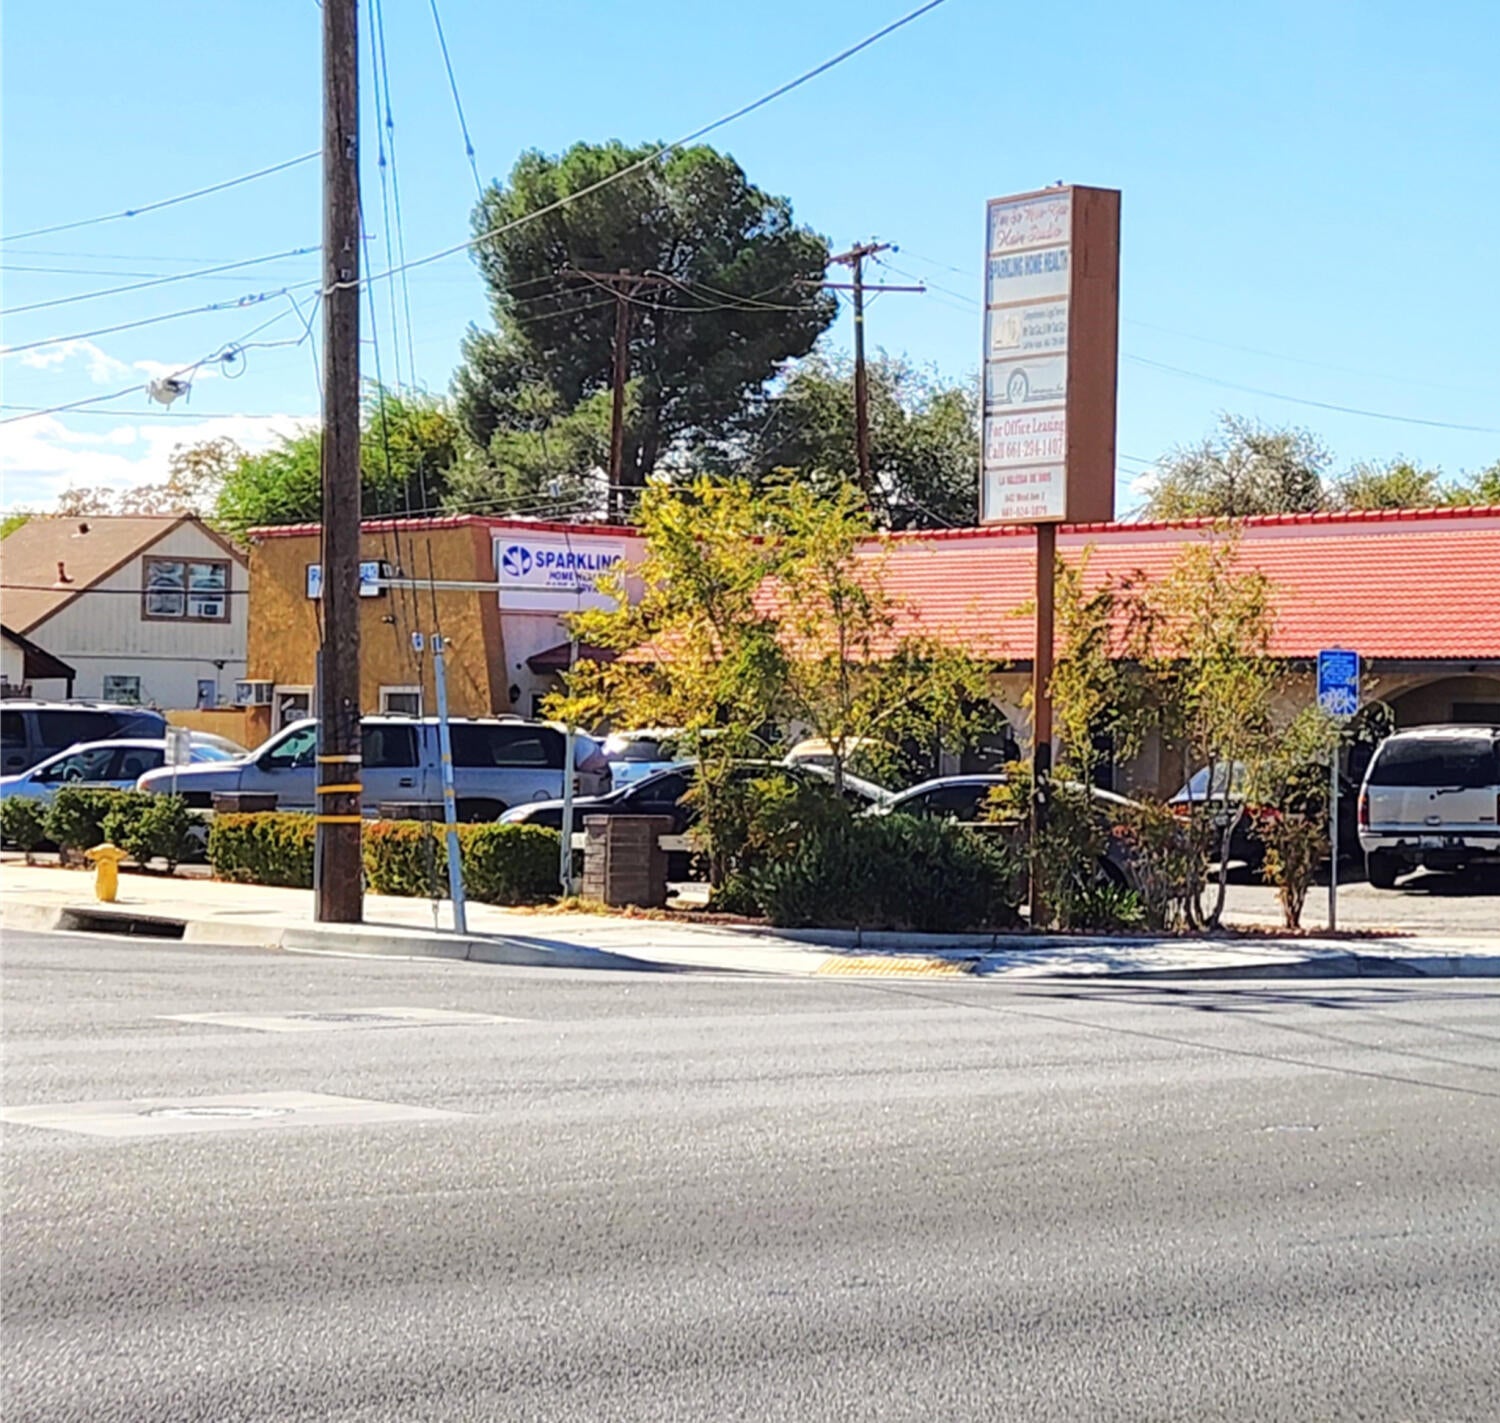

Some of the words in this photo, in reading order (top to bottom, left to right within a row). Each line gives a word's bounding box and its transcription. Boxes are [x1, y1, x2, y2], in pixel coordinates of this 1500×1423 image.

[1024, 252, 1043, 276] HOME
[986, 420, 1003, 438] For
[1004, 418, 1031, 437] Office
[1032, 416, 1065, 435] Leasing
[986, 442, 1005, 460] Call
[549, 571, 574, 581] HOME
